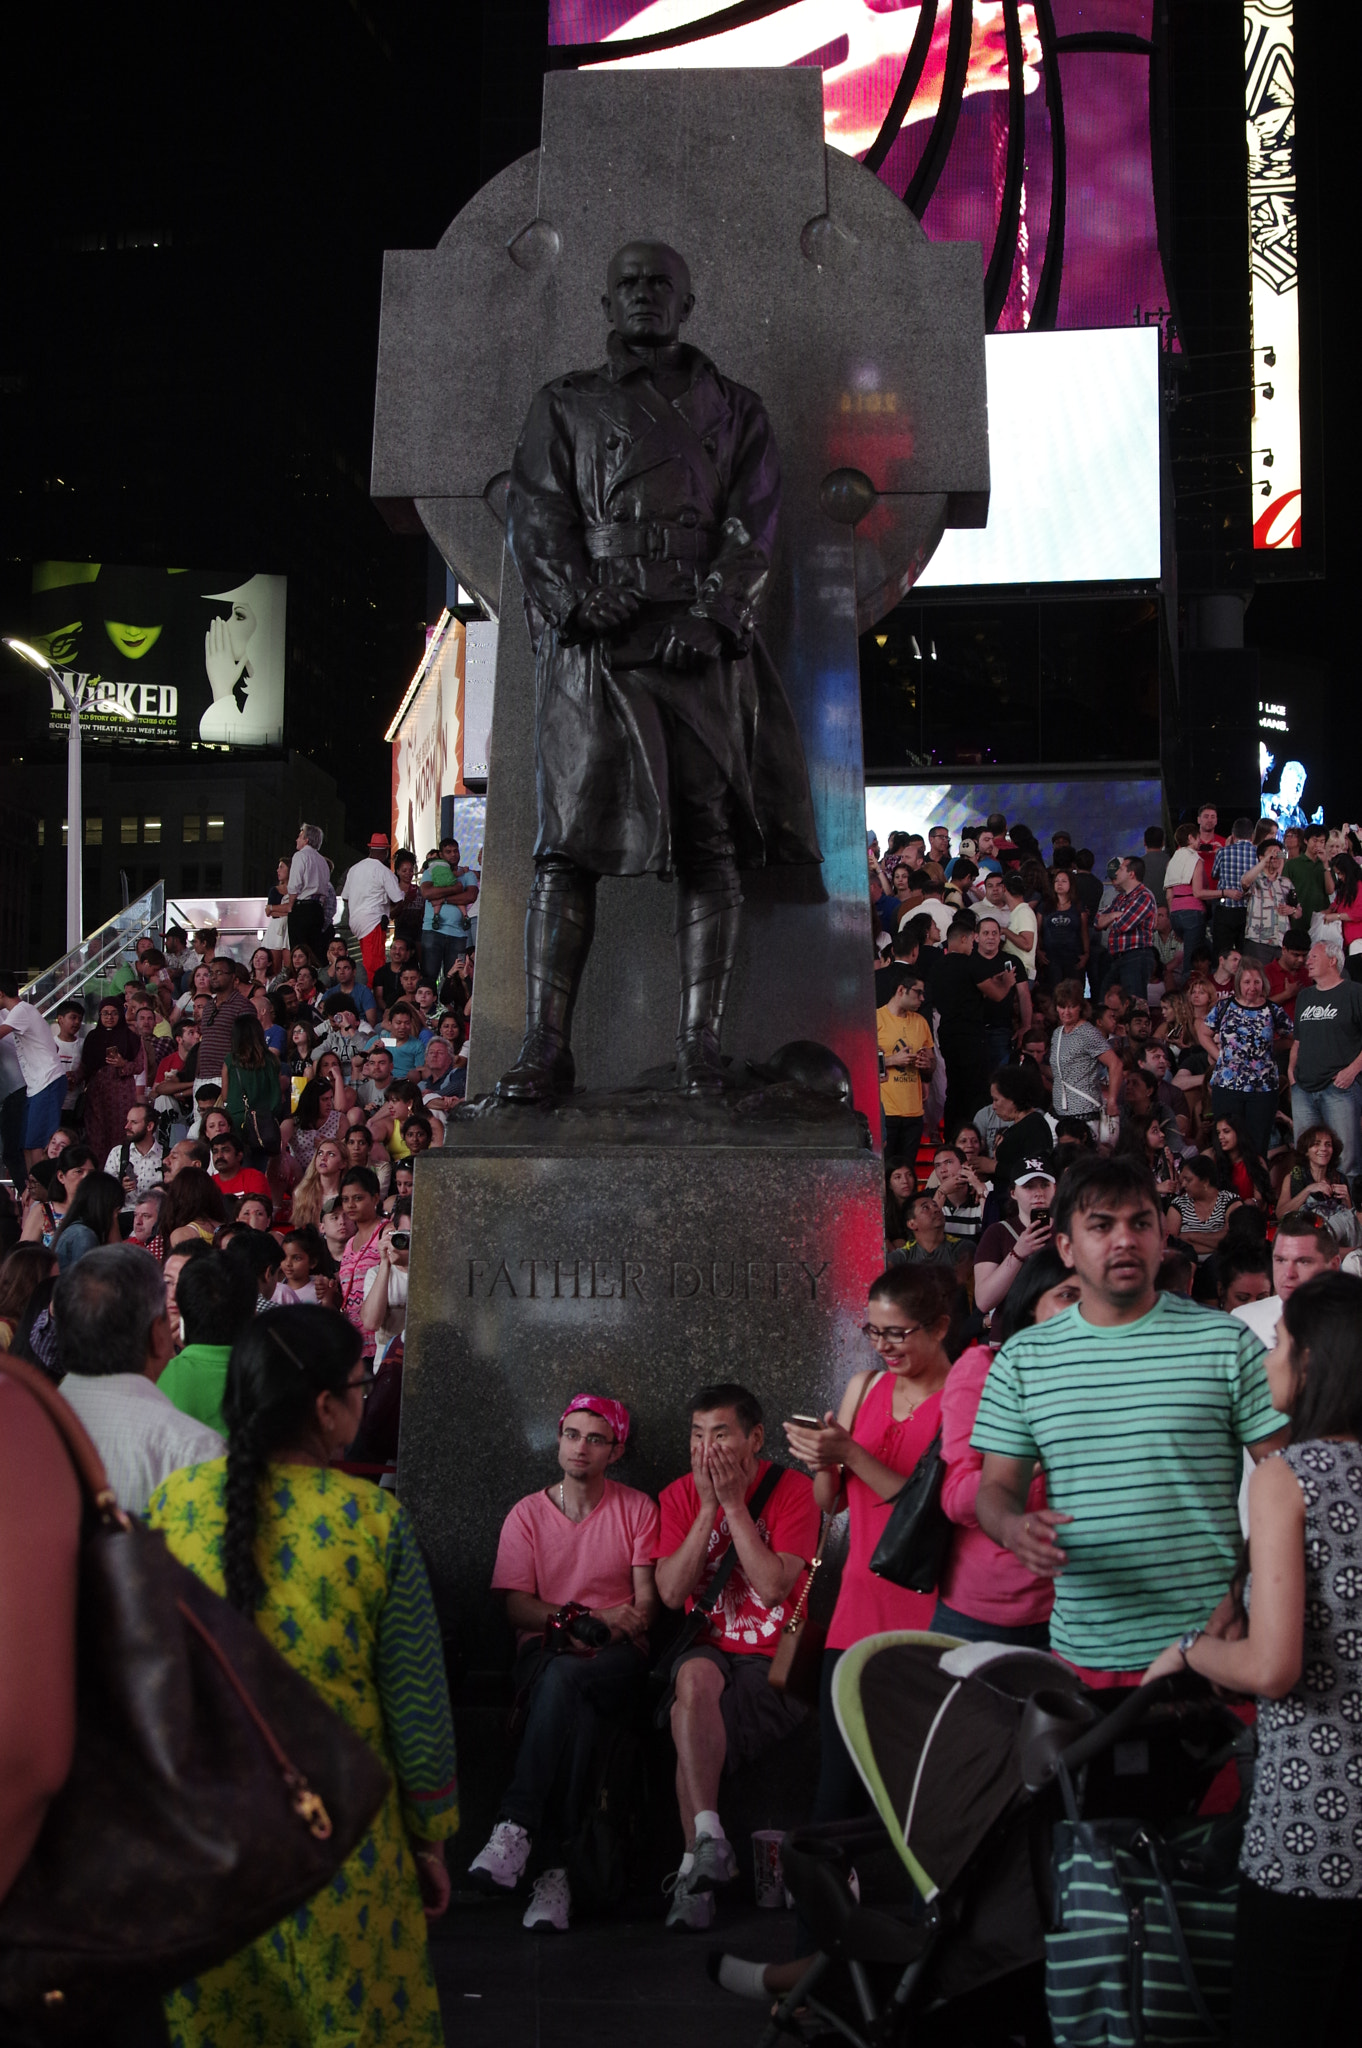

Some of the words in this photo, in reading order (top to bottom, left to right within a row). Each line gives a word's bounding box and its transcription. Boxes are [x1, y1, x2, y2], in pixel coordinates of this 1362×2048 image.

[1265, 703, 1286, 716] LIKE
[465, 1259, 650, 1301] FATHER
[669, 1261, 831, 1301] DUFFY
